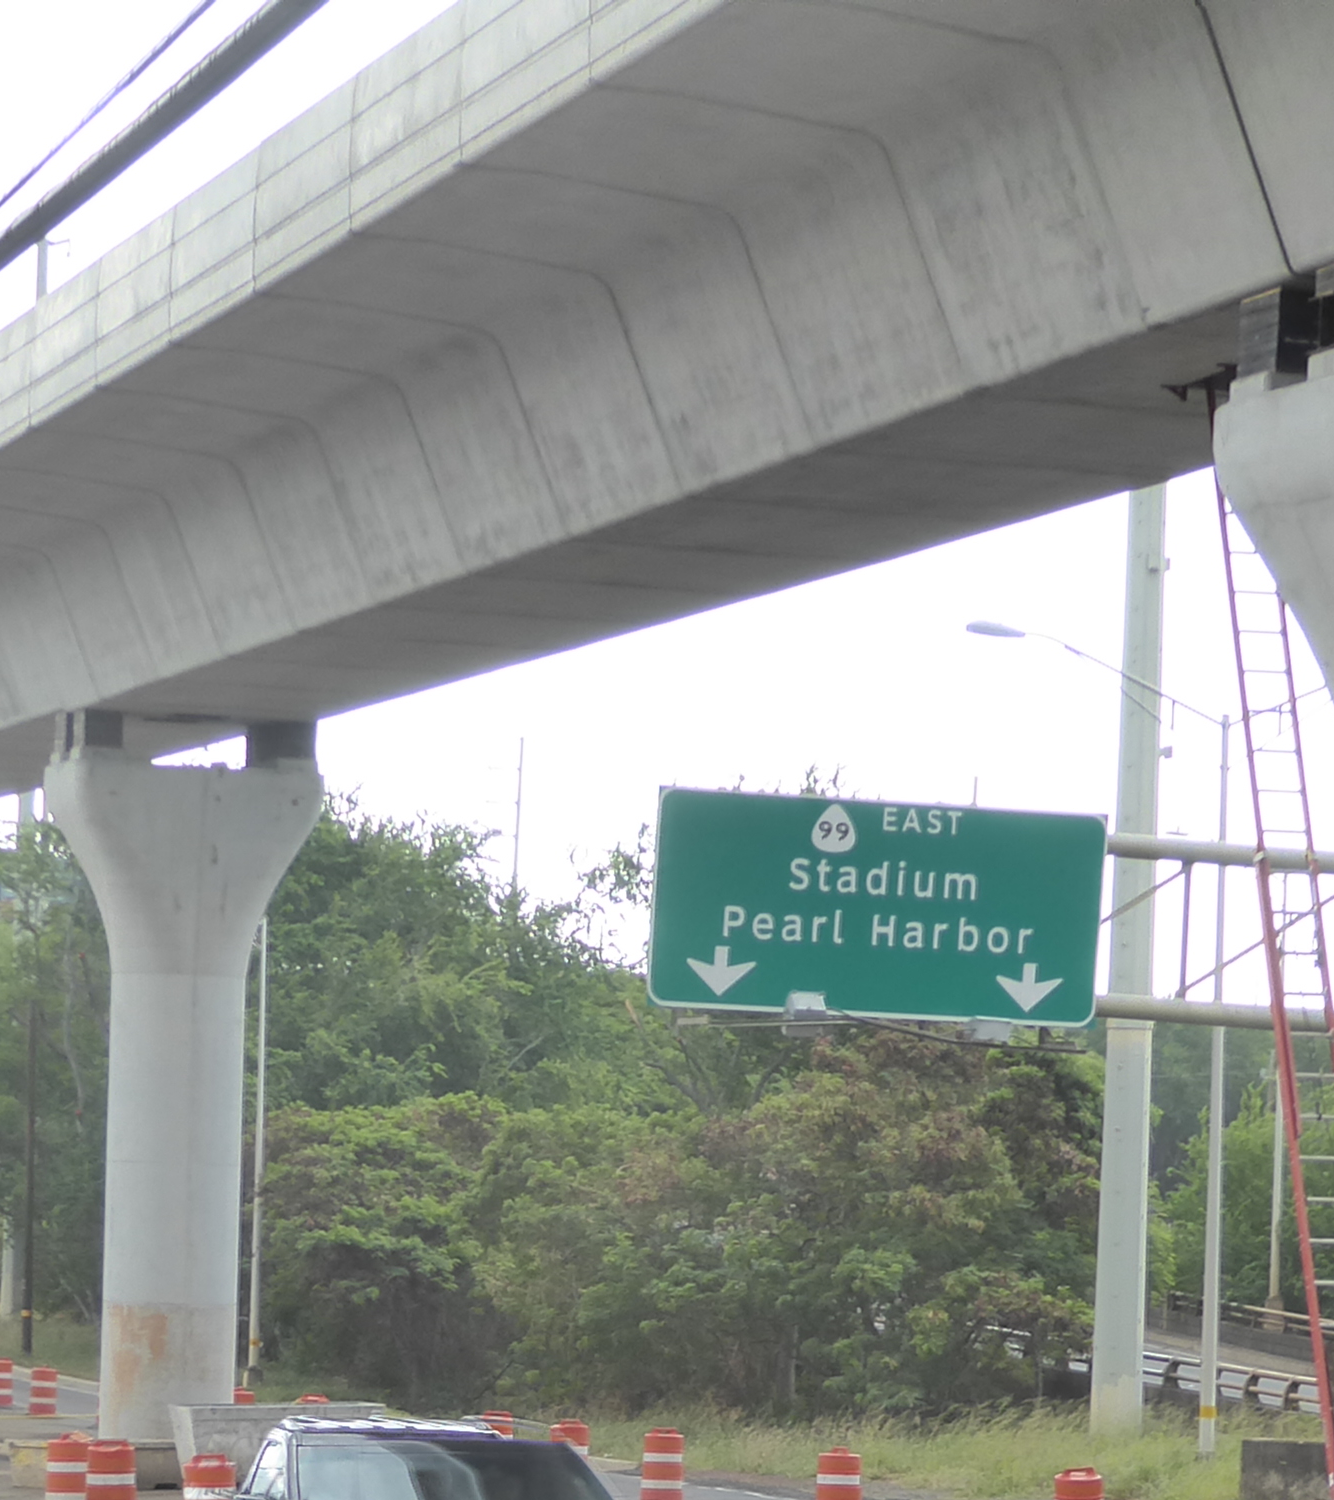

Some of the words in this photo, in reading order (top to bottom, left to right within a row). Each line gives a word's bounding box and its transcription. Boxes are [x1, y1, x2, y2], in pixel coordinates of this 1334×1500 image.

[818, 820, 850, 842] 99
[882, 806, 963, 835] EAST
[788, 857, 978, 901] Stadium
[721, 904, 844, 944] Pearl
[870, 913, 1034, 955] Harbor
